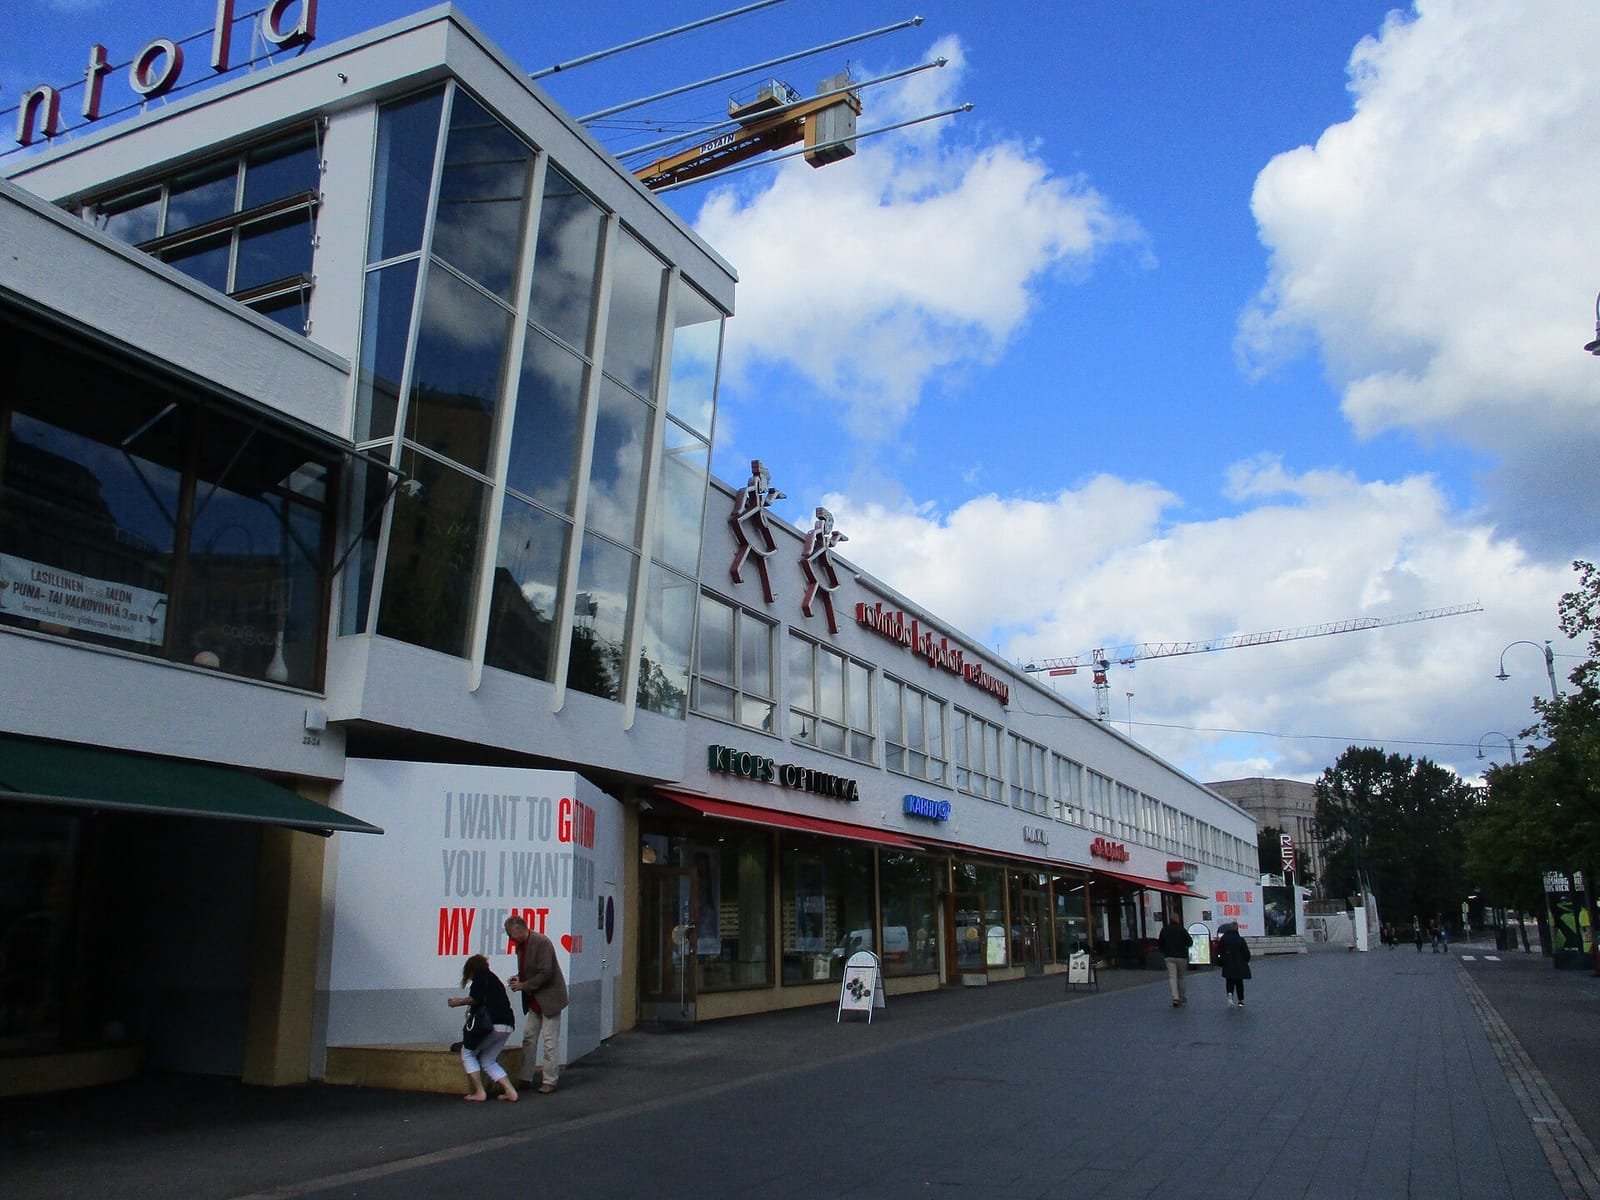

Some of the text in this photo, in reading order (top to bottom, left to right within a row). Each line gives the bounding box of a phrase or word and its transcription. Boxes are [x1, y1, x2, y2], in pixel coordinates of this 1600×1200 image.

[701, 134, 735, 153] POTAIN
[13, 582, 46, 600] PUNA-
[49, 590, 62, 605] TAI
[31, 568, 84, 593] LASILLINEN
[106, 587, 132, 603] TALON
[856, 602, 911, 647] ravintola
[708, 744, 859, 801] KEOPS OPTIIKKA
[444, 792, 452, 839] I
[459, 793, 521, 841] WANT
[526, 796, 552, 842] TO
[905, 794, 938, 819] KARHU
[1280, 834, 1295, 871] REX
[442, 850, 491, 897] YOU.
[498, 851, 506, 897] I
[512, 851, 572, 898] WANT
[437, 908, 476, 956] MY
